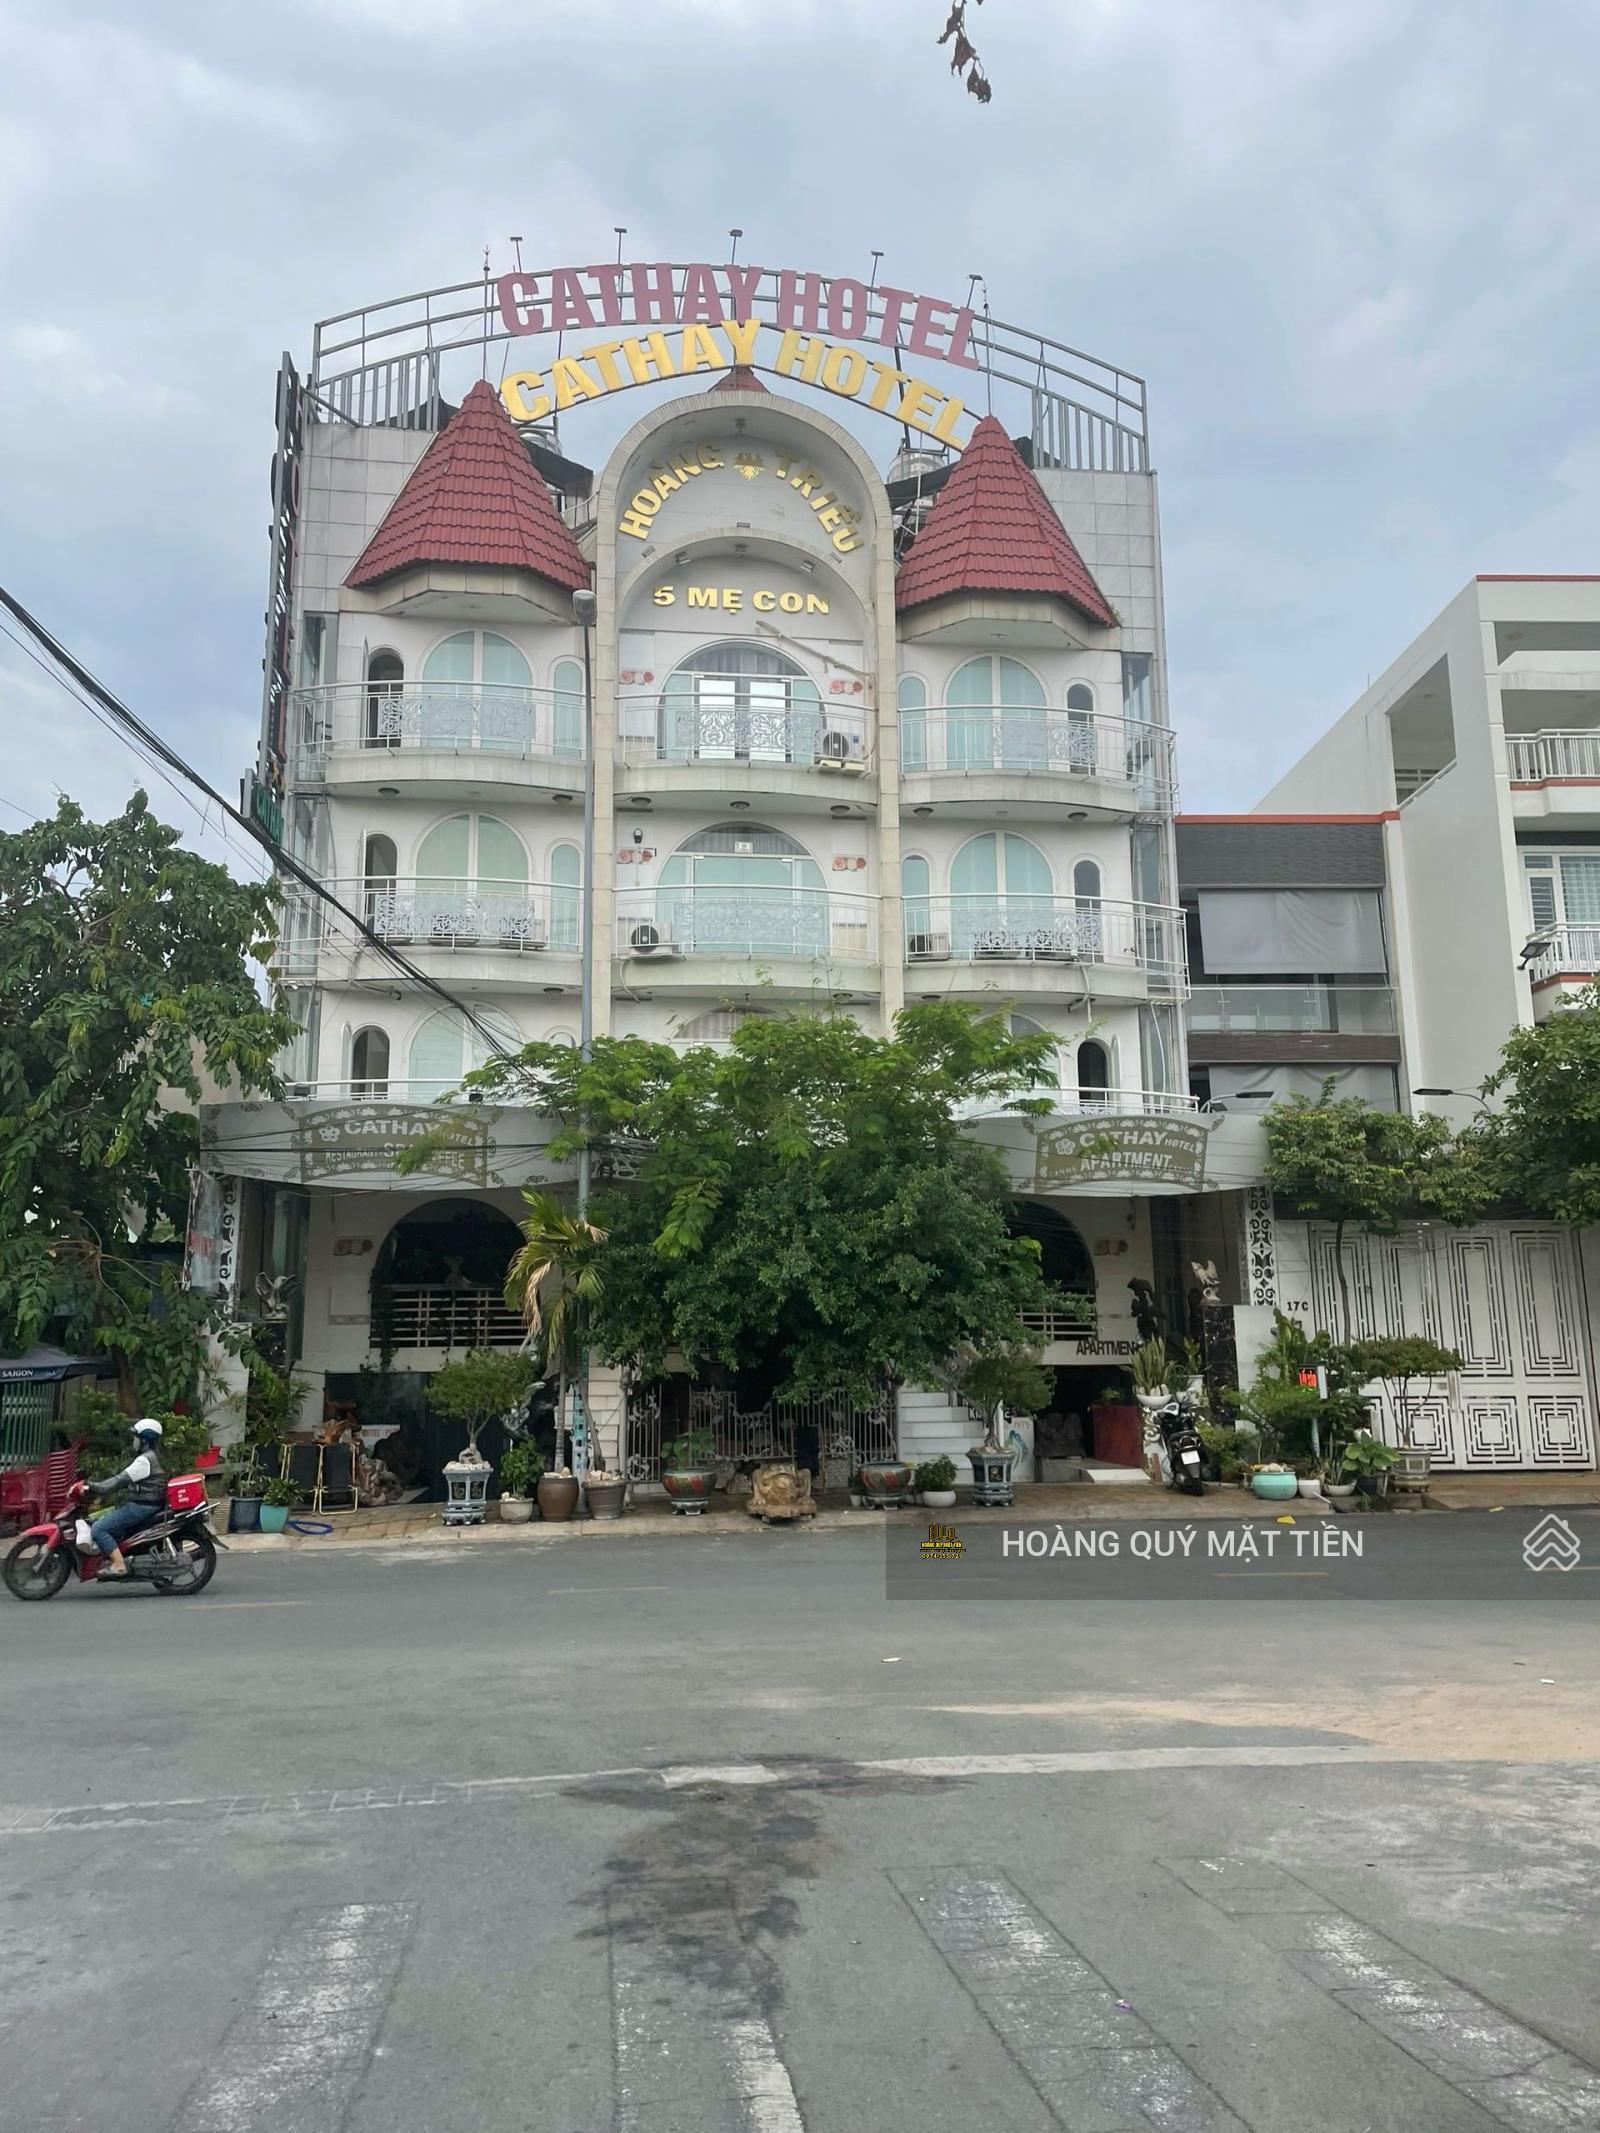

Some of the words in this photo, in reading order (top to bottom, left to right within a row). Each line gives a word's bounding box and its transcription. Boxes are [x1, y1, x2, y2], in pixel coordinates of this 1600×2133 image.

[497, 263, 764, 336] CATHAY
[777, 268, 979, 371] HOTEL
[501, 319, 762, 422] CATHAY
[775, 328, 966, 453] HOTEL
[618, 442, 725, 540] HOÀNG
[653, 586, 676, 606] 5
[688, 587, 743, 614] MẸ
[752, 590, 831, 614] CON
[1165, 1138, 1195, 1153] HOTEL
[1081, 1152, 1173, 1172] APARTMENT
[1287, 1301, 1309, 1312] 17C
[2, 1369, 33, 1378] SAIGON
